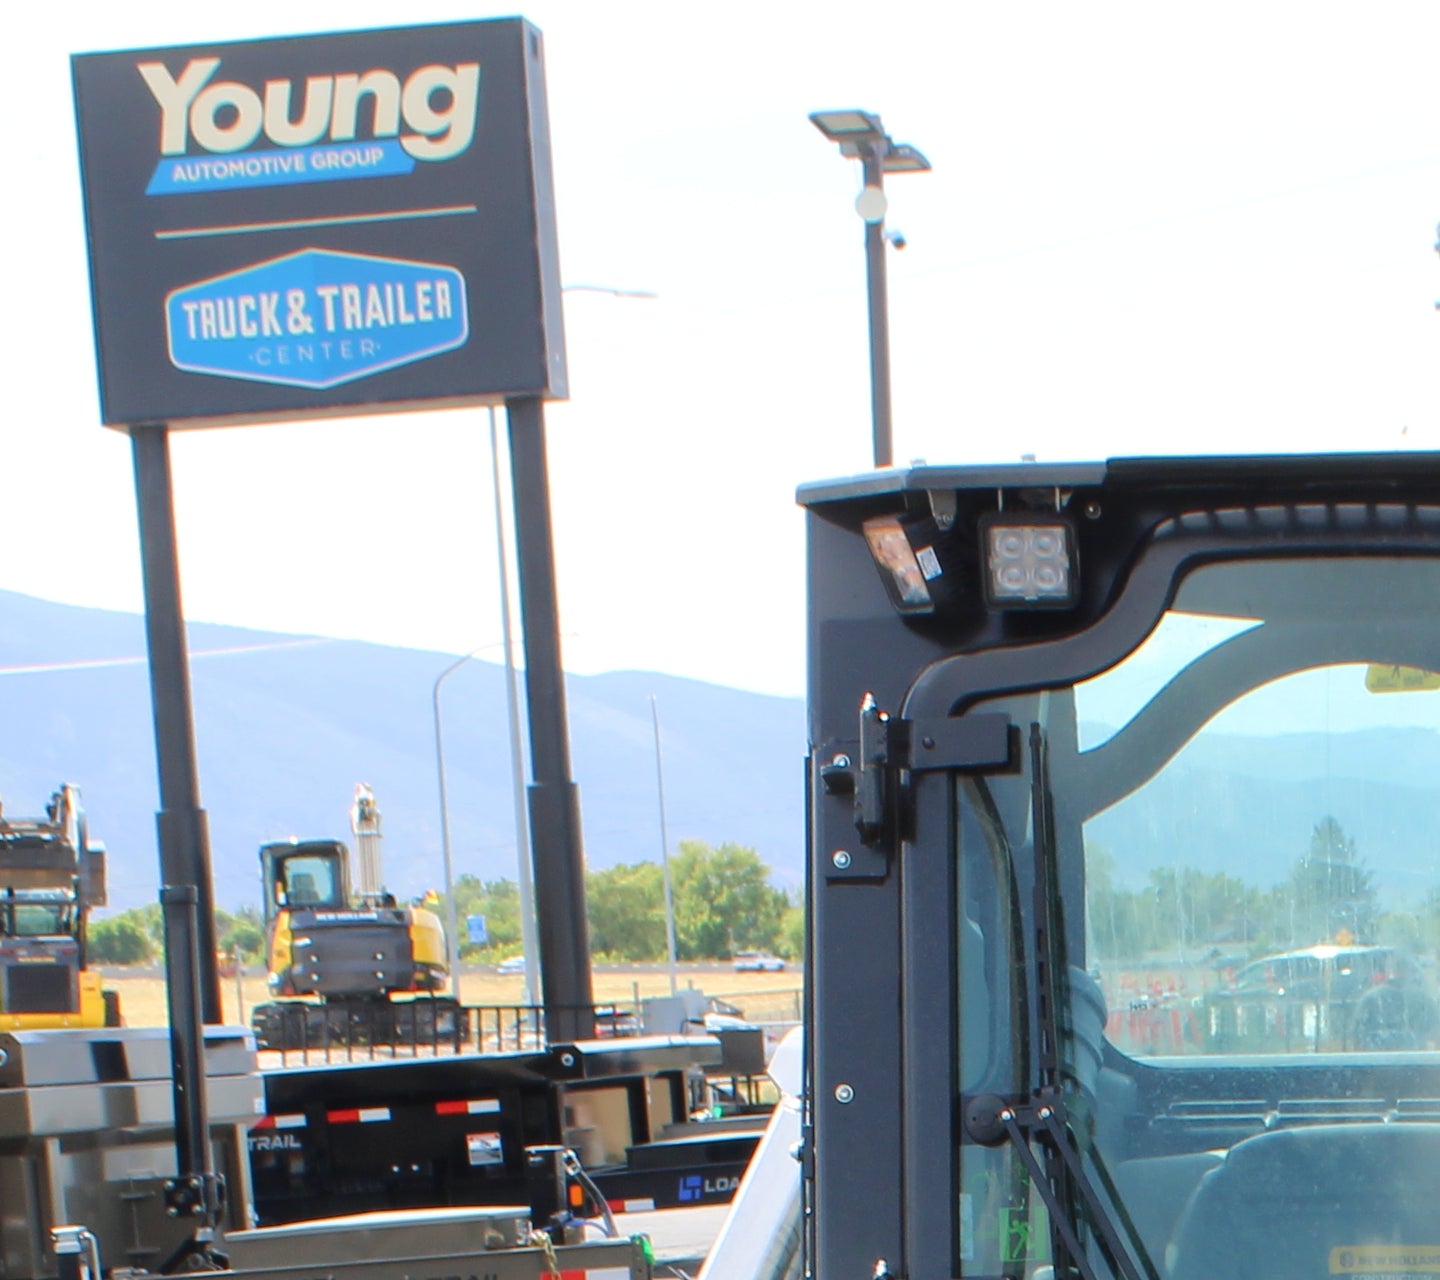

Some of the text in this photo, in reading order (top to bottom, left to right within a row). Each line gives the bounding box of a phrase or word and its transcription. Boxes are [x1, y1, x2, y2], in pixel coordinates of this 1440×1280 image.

[136, 57, 480, 162] Young
[171, 147, 385, 183] AUTOMOTIVE GROUP
[181, 279, 454, 341] TRUCK & TRAILER
[253, 338, 377, 366] CENTER
[247, 1134, 303, 1151] TRAIL
